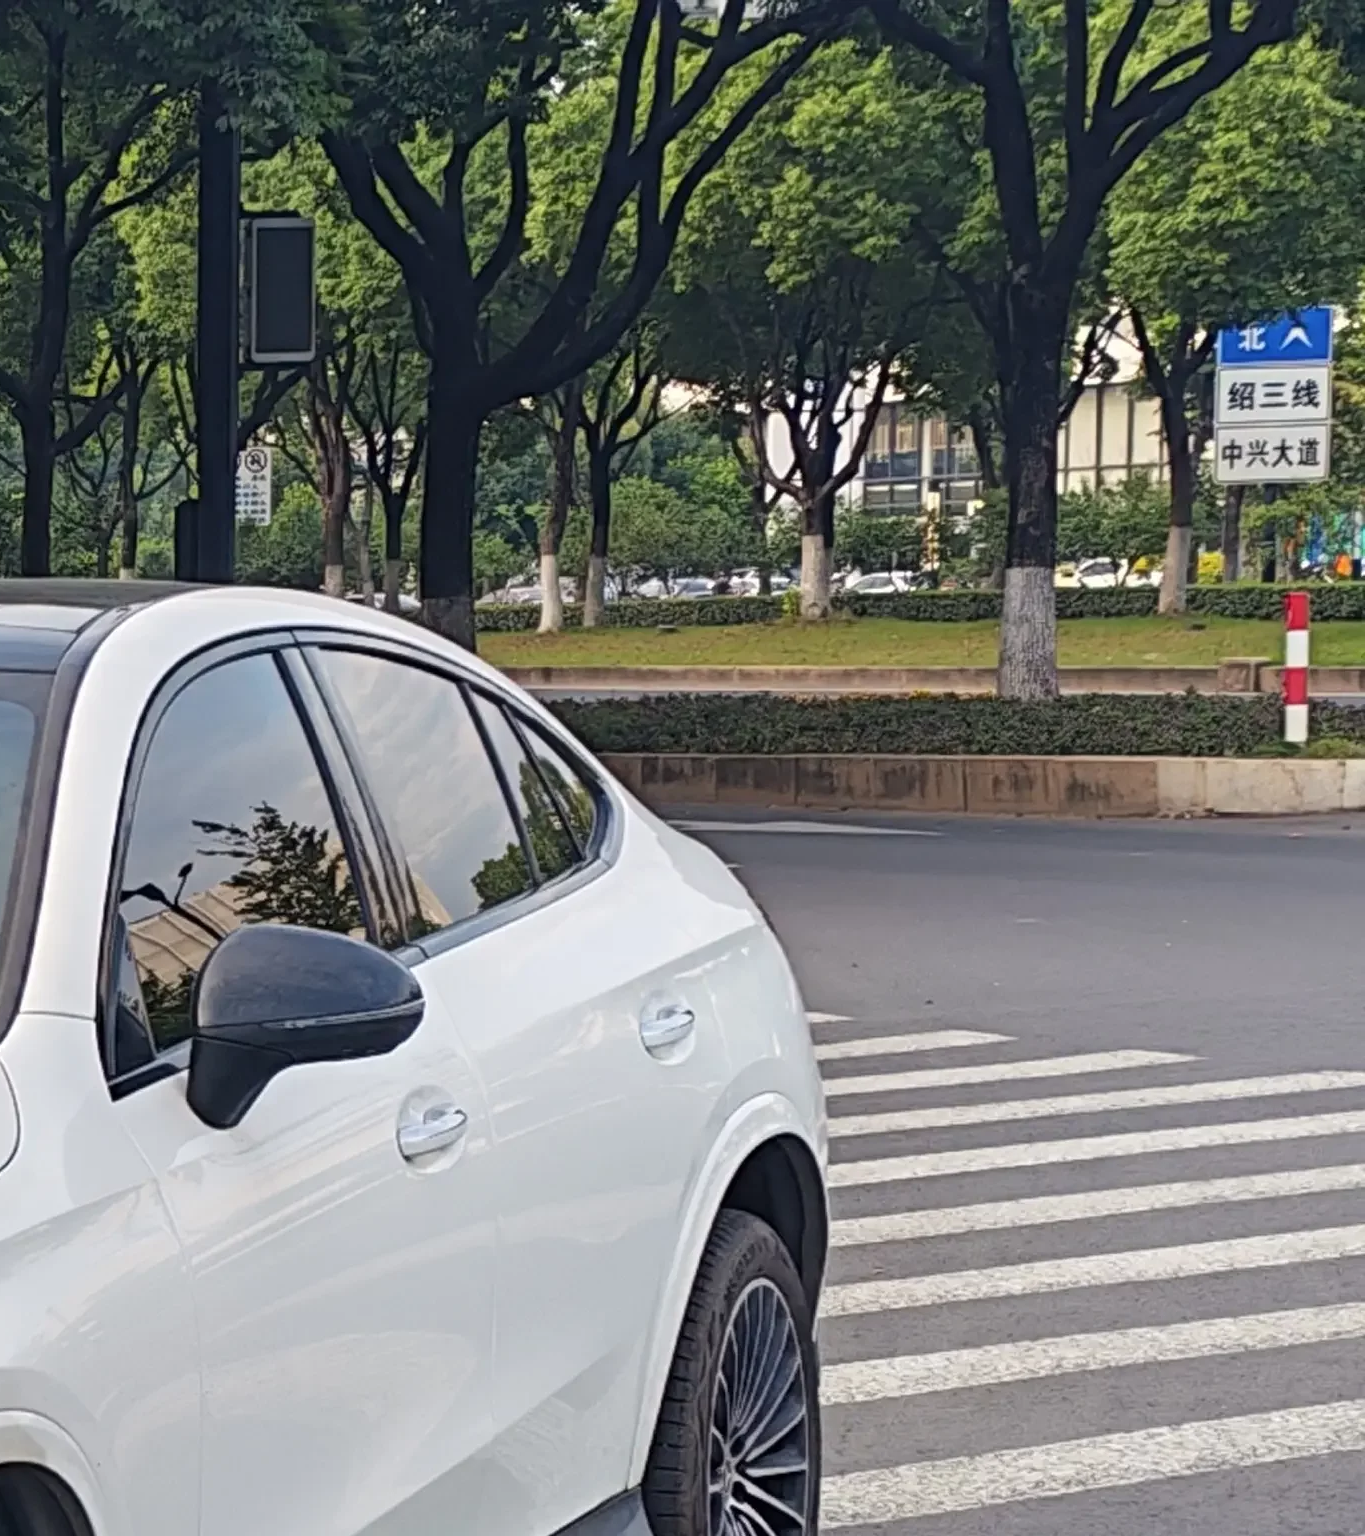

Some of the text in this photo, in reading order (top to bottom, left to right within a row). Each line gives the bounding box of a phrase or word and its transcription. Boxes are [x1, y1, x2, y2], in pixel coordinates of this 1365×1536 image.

[1238, 326, 1266, 351] 北
[1227, 379, 1321, 411] 绍三线
[1221, 438, 1321, 469] 中兴大道
